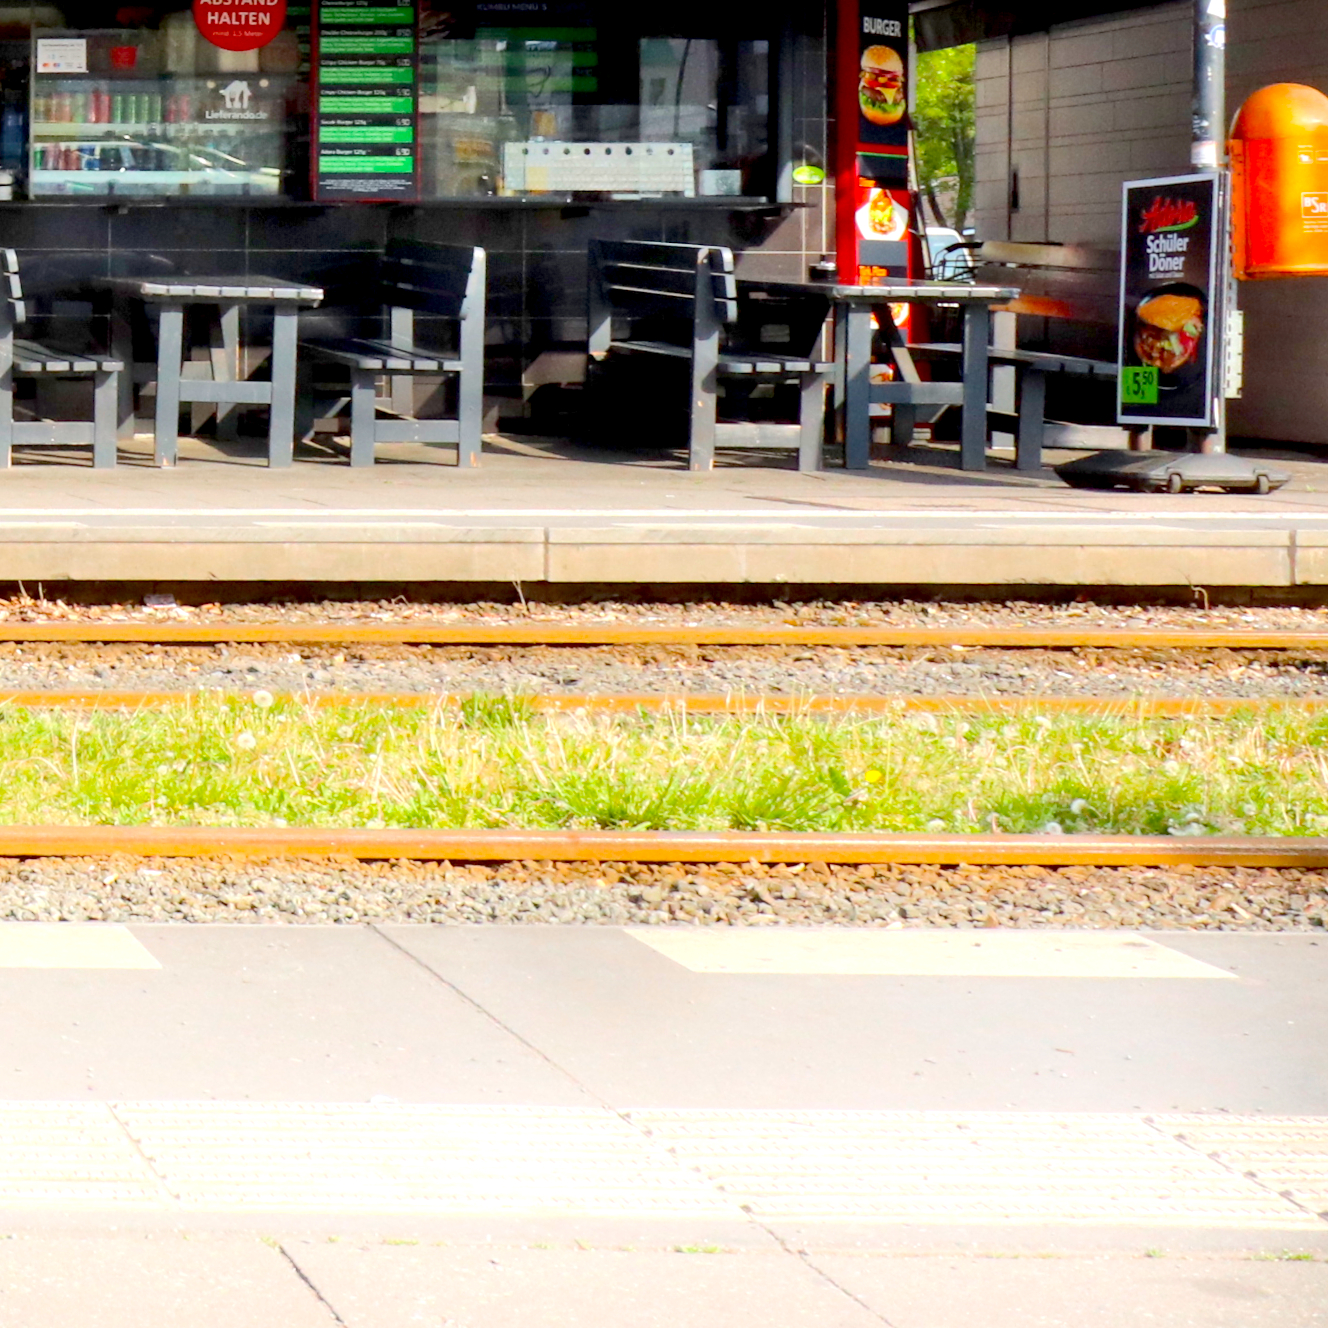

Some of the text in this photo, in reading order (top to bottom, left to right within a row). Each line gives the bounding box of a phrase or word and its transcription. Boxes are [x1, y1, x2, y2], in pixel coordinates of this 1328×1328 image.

[207, 11, 271, 25] HALTEN
[862, 15, 902, 38] BURGER
[1303, 196, 1327, 213] BSR
[1146, 232, 1190, 254] Schüler
[1149, 253, 1186, 272] Döner
